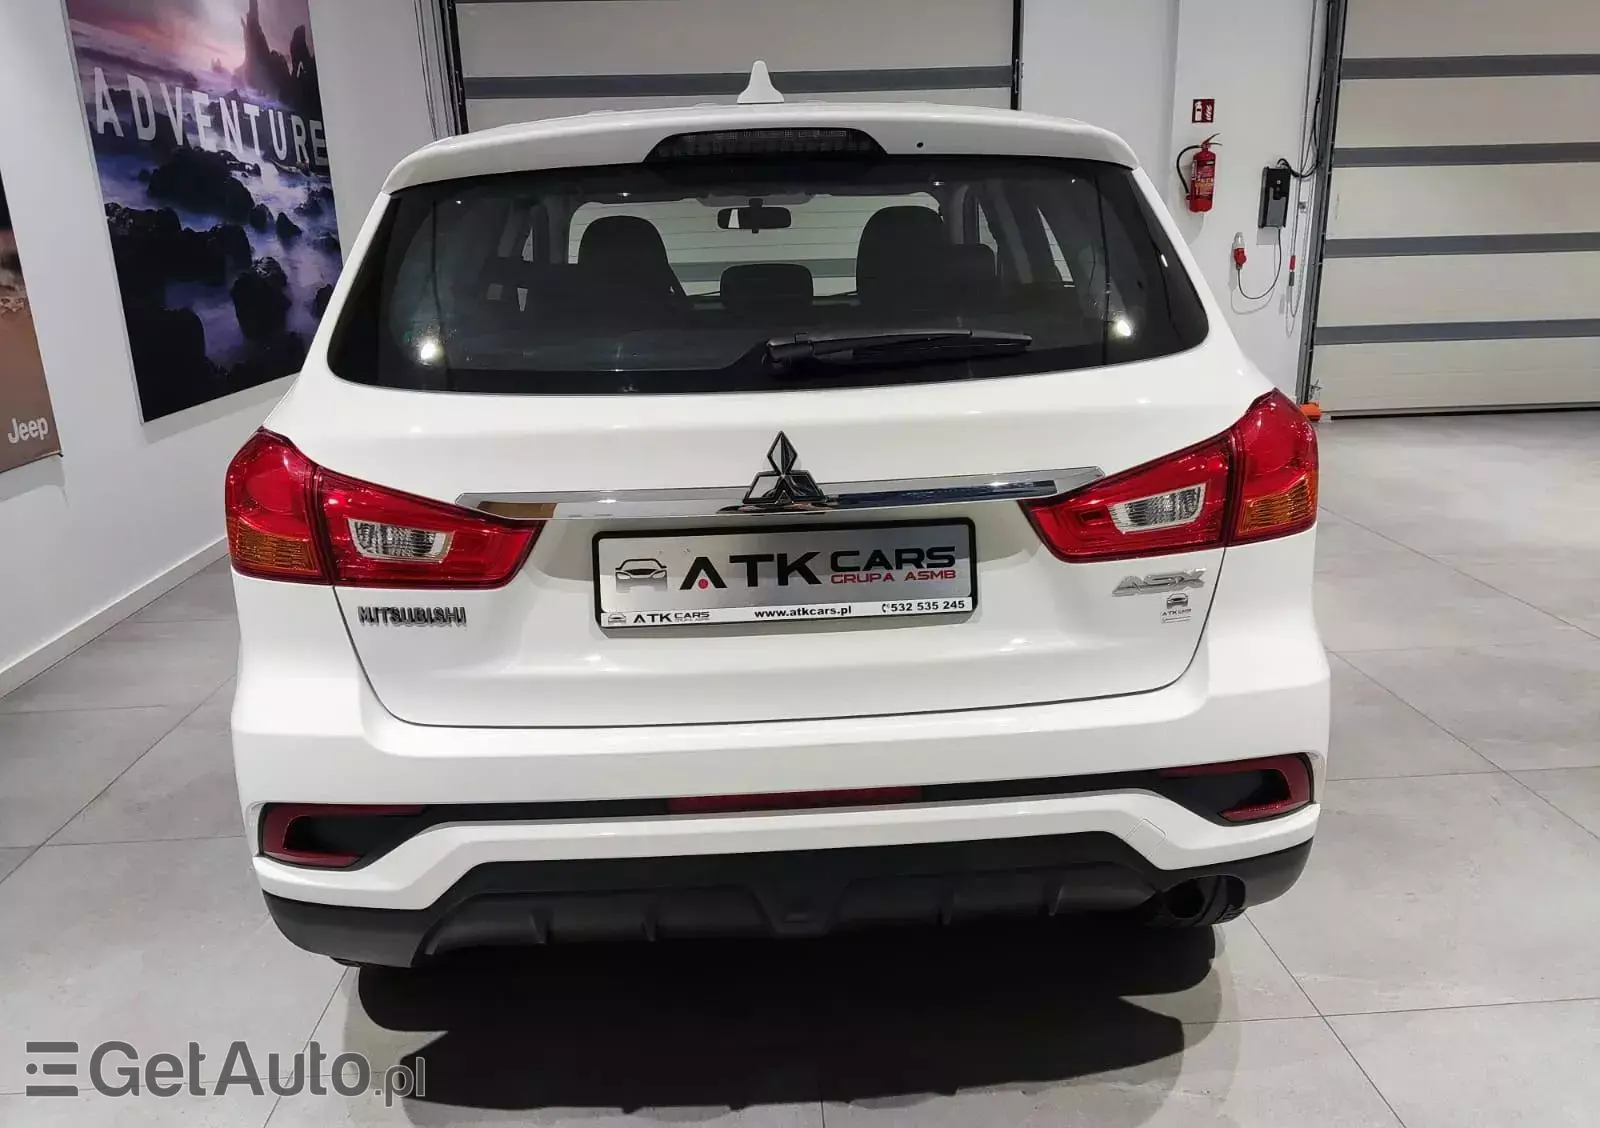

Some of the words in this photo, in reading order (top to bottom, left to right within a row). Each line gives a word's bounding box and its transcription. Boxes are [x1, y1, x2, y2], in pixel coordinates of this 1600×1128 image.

[94, 66, 328, 166] ADVENTURE
[7, 417, 49, 444] Jeep
[679, 551, 822, 590] ATK
[830, 545, 956, 573] CARS
[830, 571, 895, 584] GRUPA
[904, 569, 957, 582] ASMB
[1111, 567, 1207, 597] ASX
[357, 606, 467, 625] MITSUBISHI
[754, 605, 852, 618] www.atkcars.pl
[890, 601, 913, 613] 532
[916, 600, 939, 611] 535
[943, 599, 966, 610] 245
[633, 612, 672, 624] ATK
[674, 611, 710, 619] CARS
